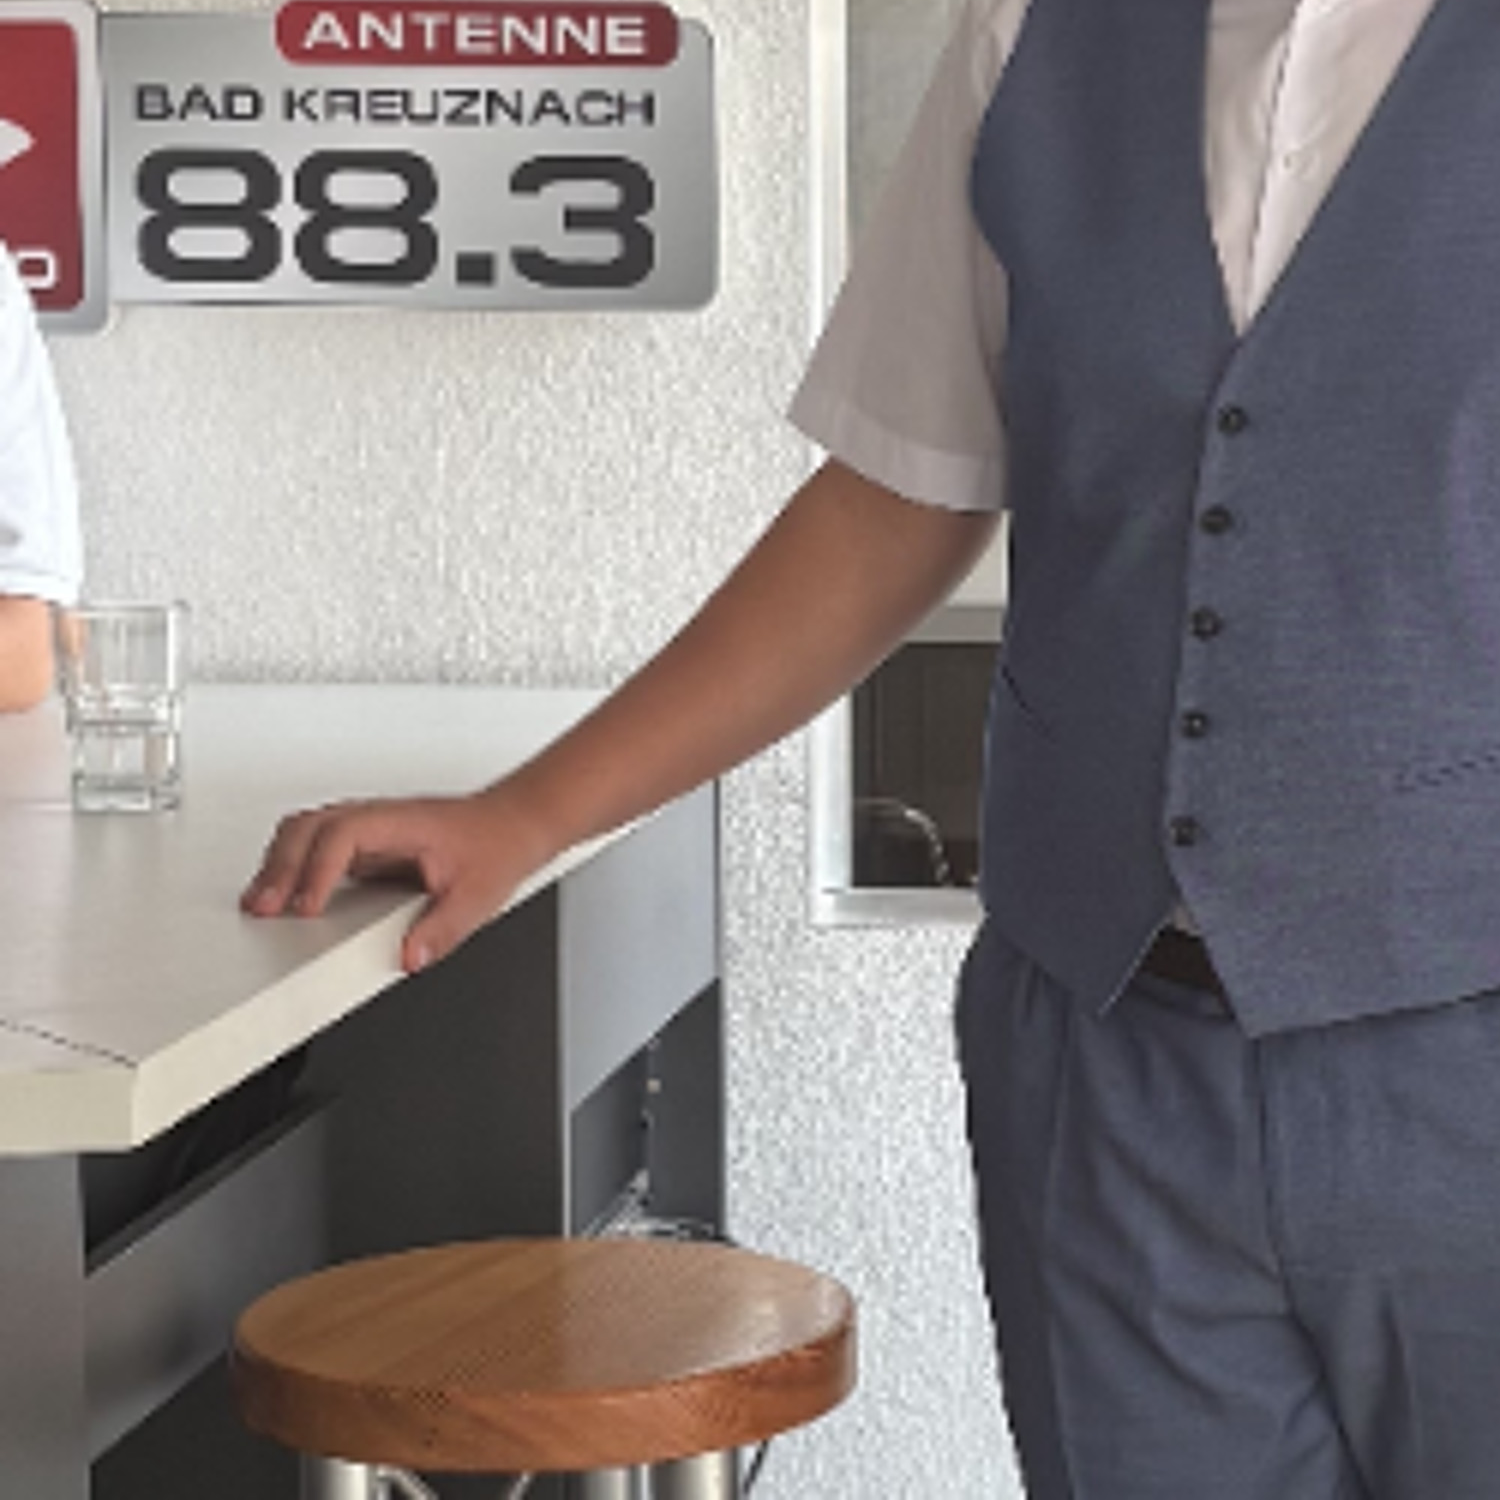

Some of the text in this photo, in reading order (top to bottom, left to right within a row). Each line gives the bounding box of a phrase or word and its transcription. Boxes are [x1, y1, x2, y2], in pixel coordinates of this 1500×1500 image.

[302, 11, 648, 57] ANTENNE
[136, 84, 656, 128] BAD KREUZNACH
[135, 147, 657, 290] 88.3
